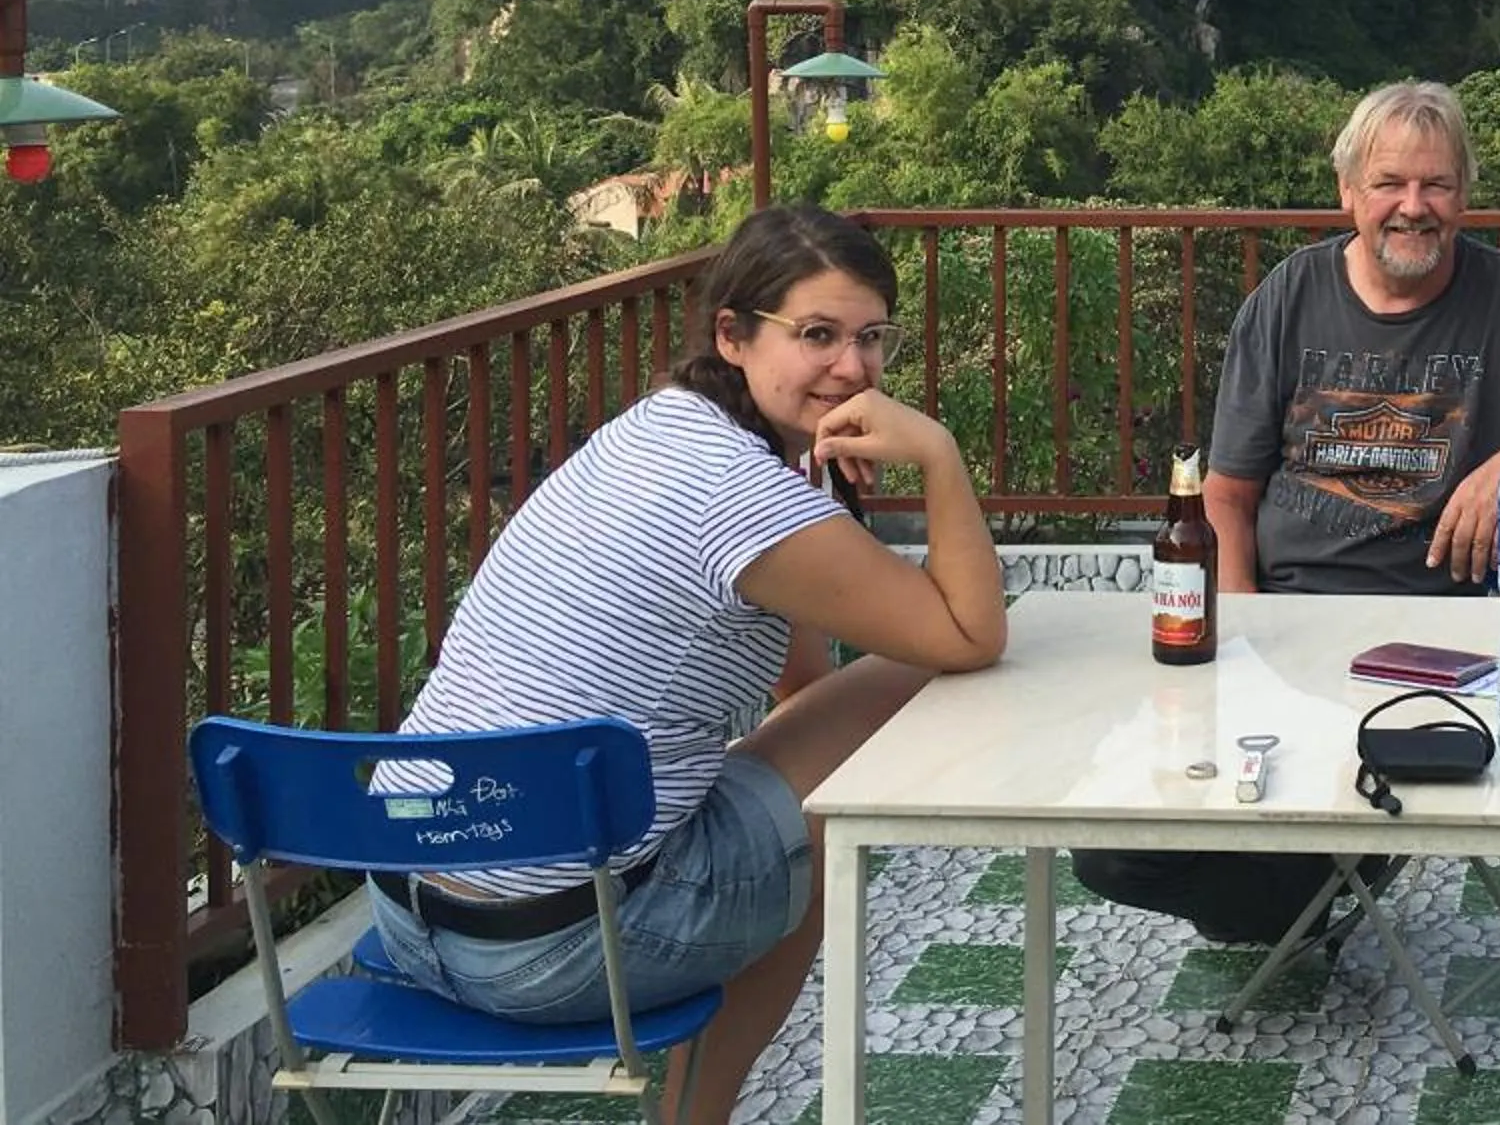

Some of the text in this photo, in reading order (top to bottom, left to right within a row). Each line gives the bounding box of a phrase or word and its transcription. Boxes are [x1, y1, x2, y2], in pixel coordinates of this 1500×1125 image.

[1299, 348, 1484, 393] HARLEY
[1349, 422, 1414, 441] MOTOR
[1315, 441, 1440, 472] HARLEY-DAVIDSON
